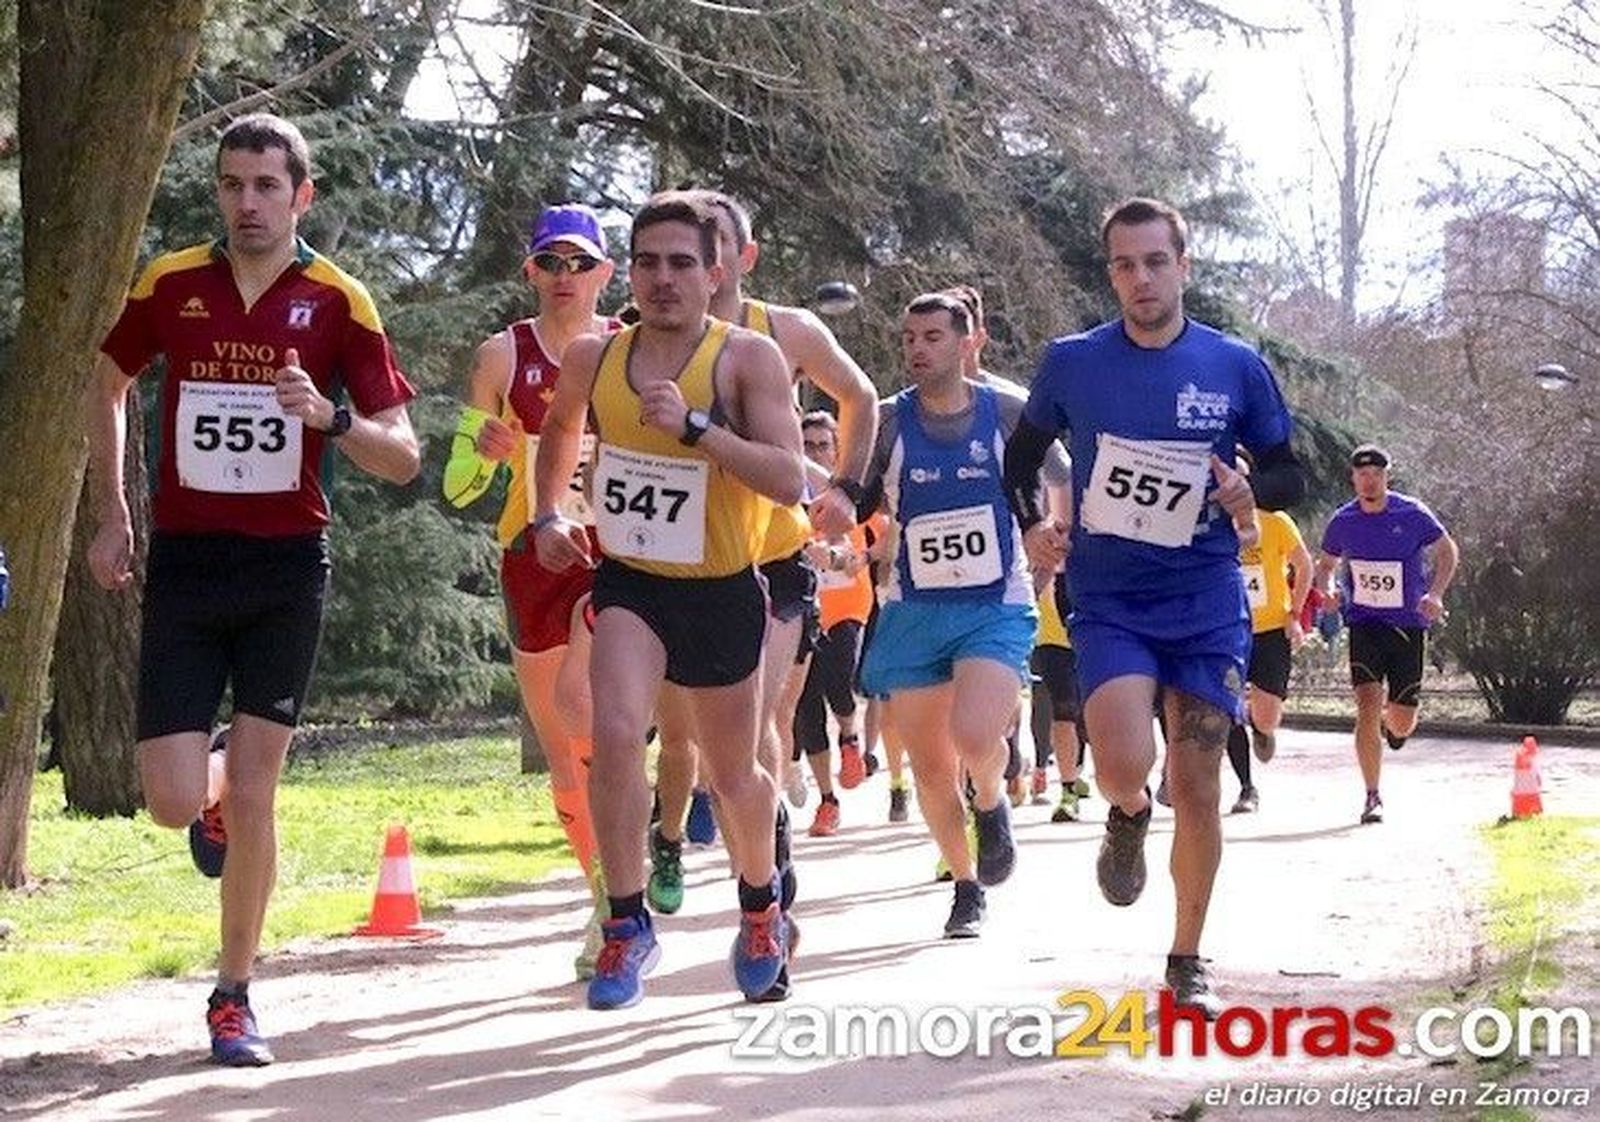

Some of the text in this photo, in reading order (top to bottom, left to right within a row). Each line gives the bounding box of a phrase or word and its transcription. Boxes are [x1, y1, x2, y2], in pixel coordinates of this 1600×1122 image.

[213, 341, 275, 363] VINO
[191, 361, 276, 383] DE TOR
[193, 415, 287, 453] 553
[604, 478, 689, 523] 547
[1105, 466, 1191, 512] 557
[920, 531, 986, 564] 550
[1359, 574, 1395, 592] 559
